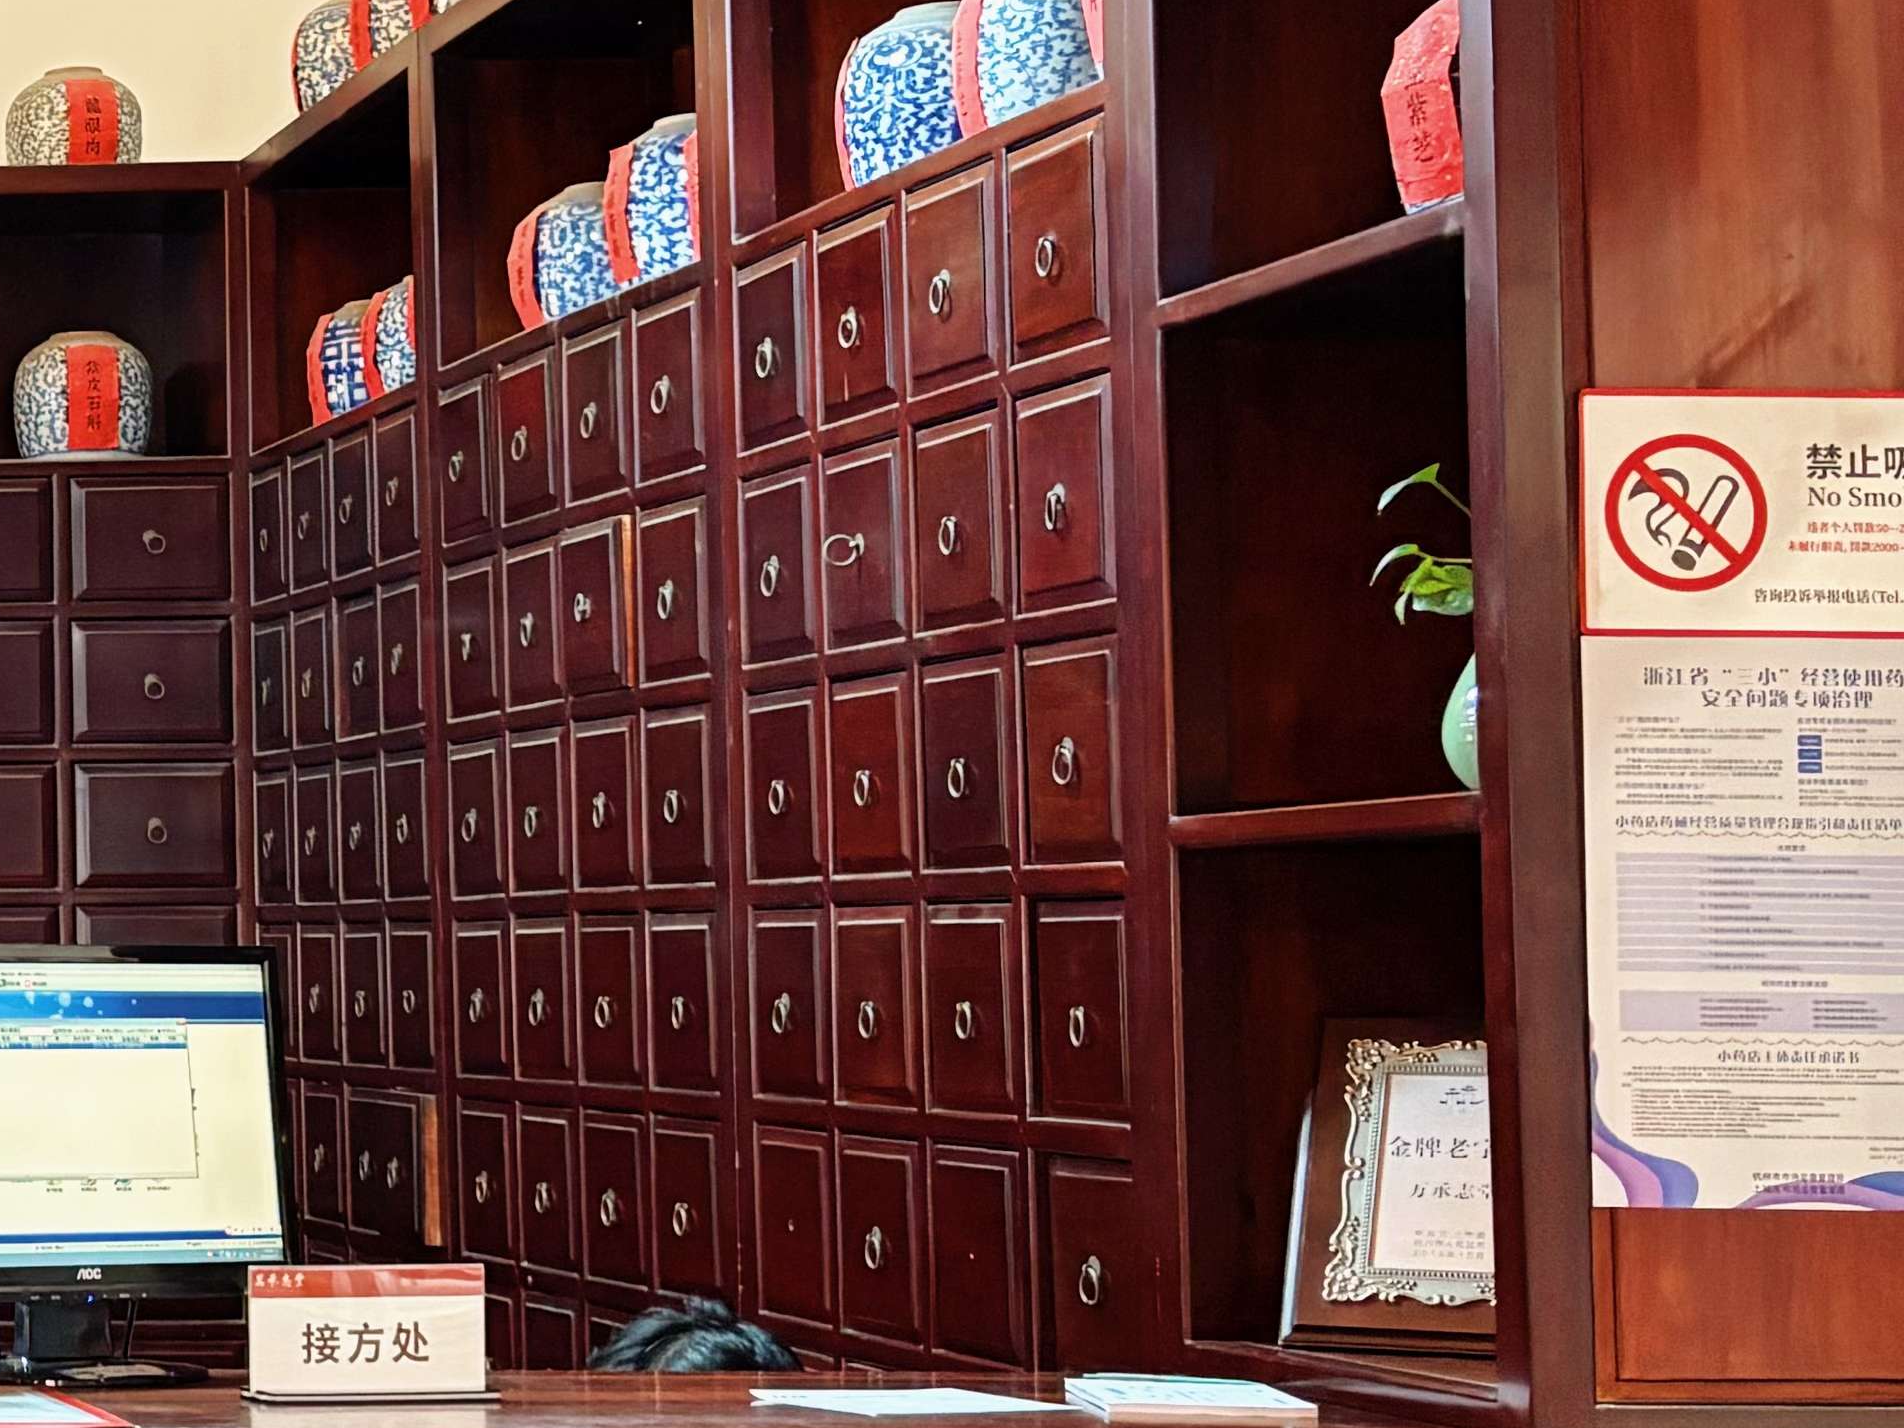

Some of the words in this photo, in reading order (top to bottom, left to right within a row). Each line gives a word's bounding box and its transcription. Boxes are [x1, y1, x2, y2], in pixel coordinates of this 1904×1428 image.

[1808, 487, 1841, 507] No
[1701, 689, 1873, 709] 安全问题专项治理
[76, 1267, 102, 1281] AOC
[302, 1321, 430, 1364] 接方处
